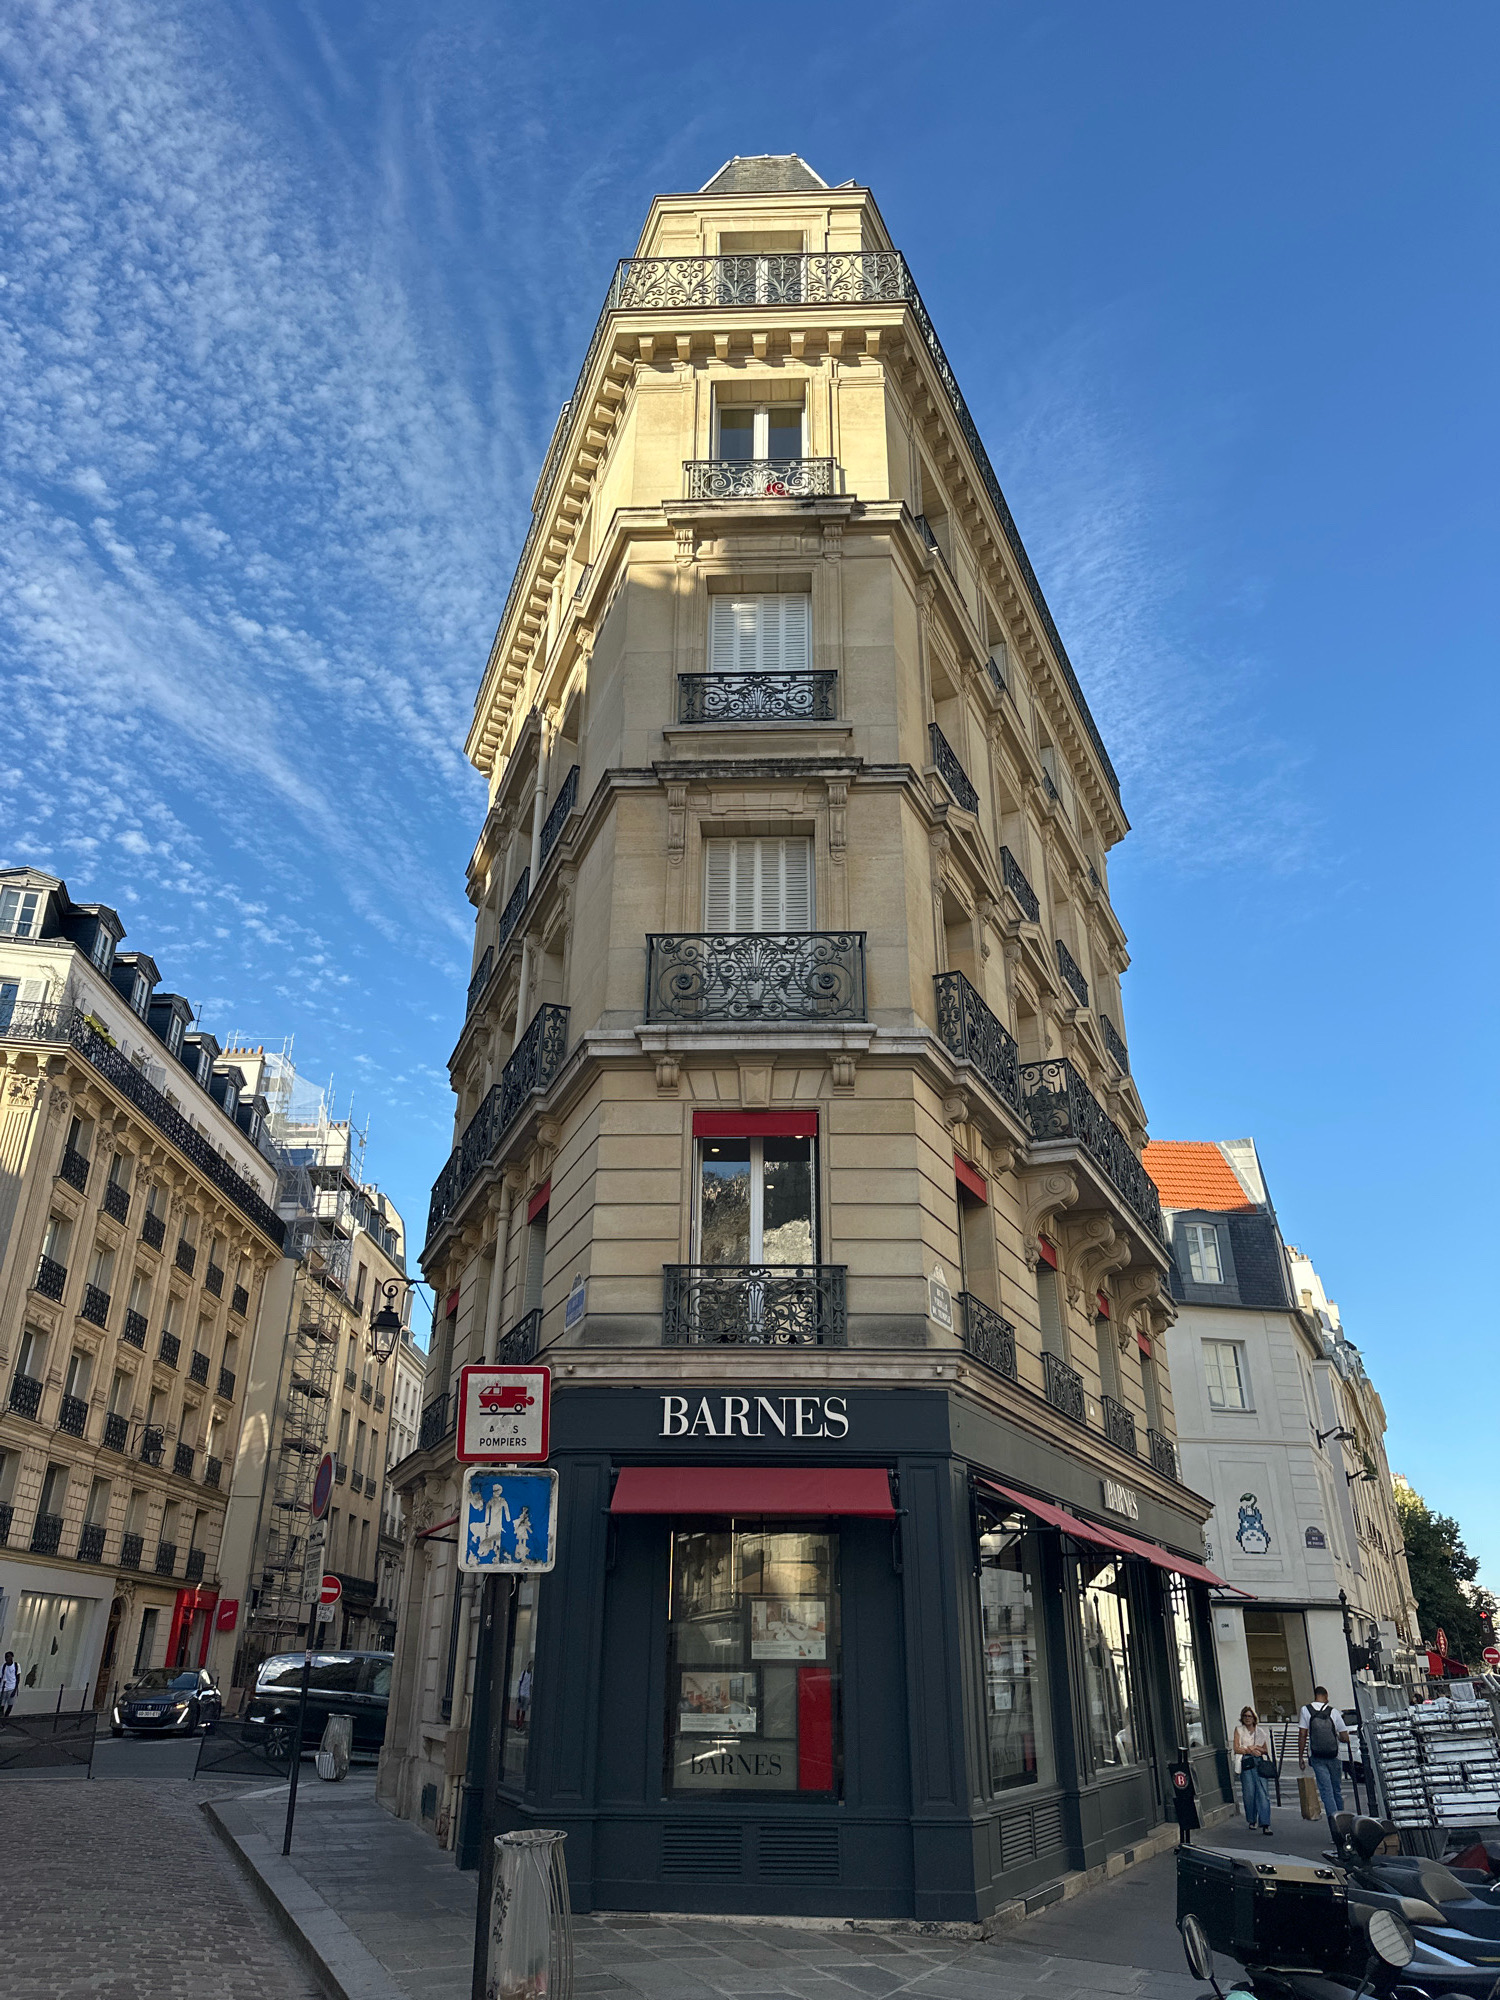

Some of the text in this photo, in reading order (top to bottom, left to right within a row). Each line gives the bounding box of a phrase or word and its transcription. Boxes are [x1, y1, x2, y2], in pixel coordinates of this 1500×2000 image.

[659, 1396, 849, 1438] BARNES
[479, 1437, 527, 1446] POMPIERS
[1102, 1479, 1139, 1520] BARNES
[689, 1753, 782, 1776] BARNES
